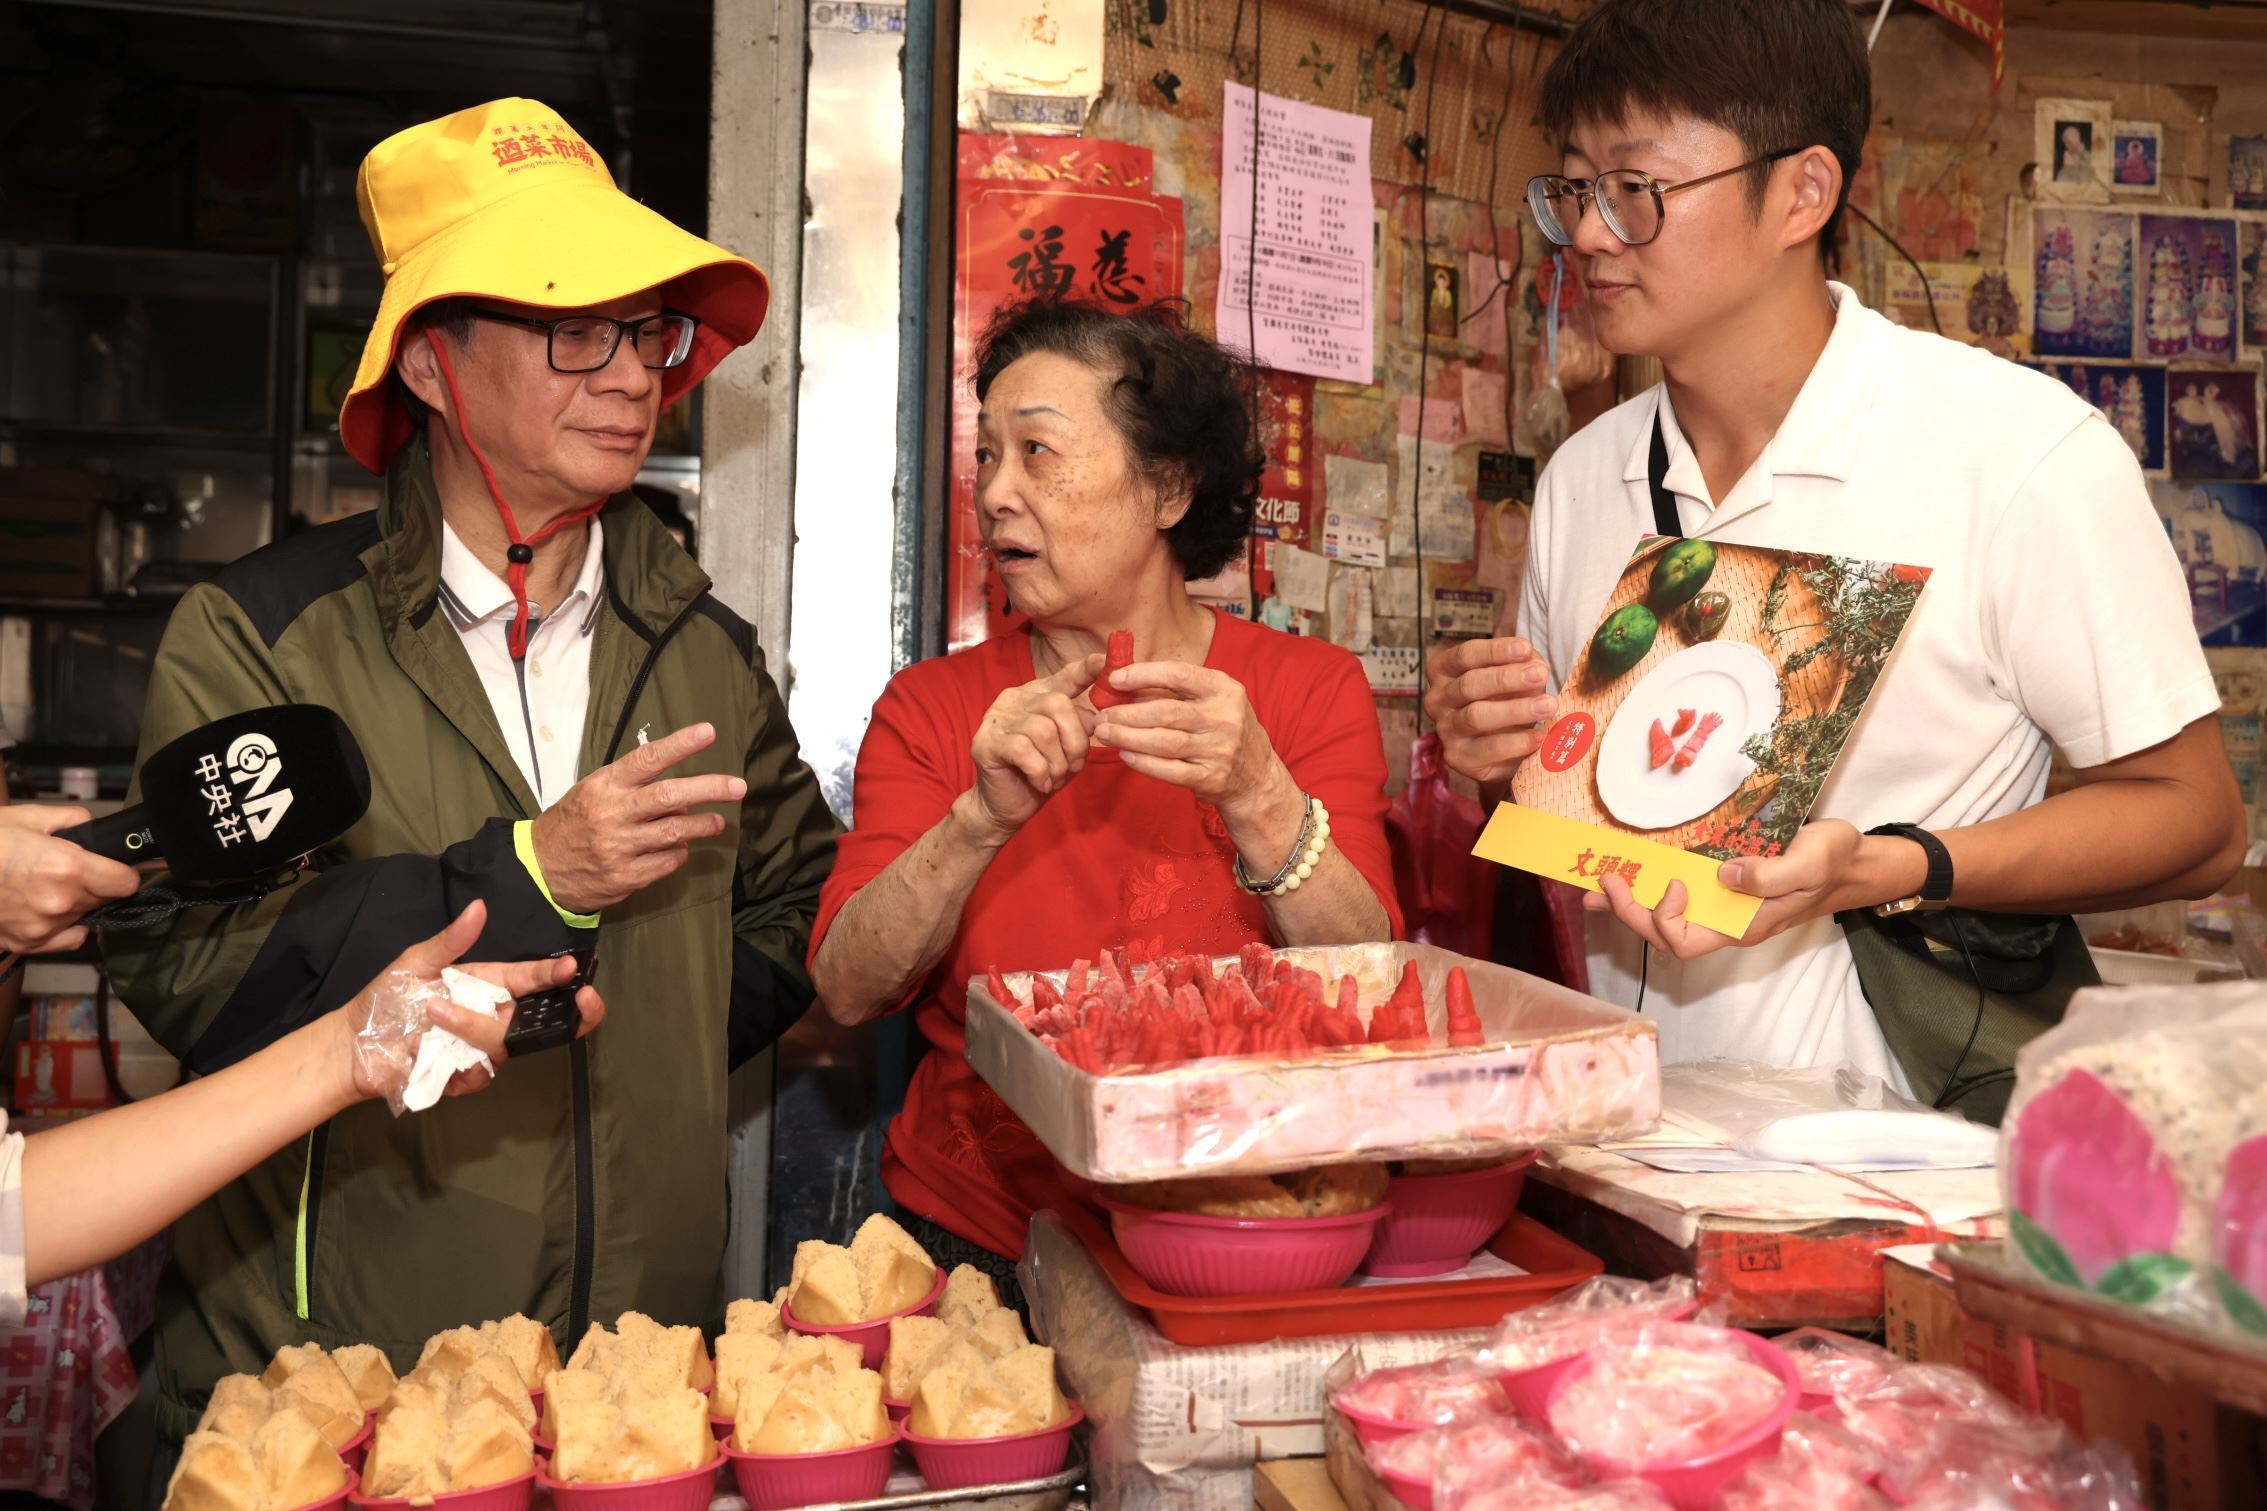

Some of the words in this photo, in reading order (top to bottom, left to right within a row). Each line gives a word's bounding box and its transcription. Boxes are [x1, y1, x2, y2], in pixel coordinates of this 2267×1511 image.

[1007, 225, 1076, 300] 福
[1556, 721, 1585, 766] 特別篇
[194, 753, 247, 848] 中央社
[226, 732, 294, 842] CNA
